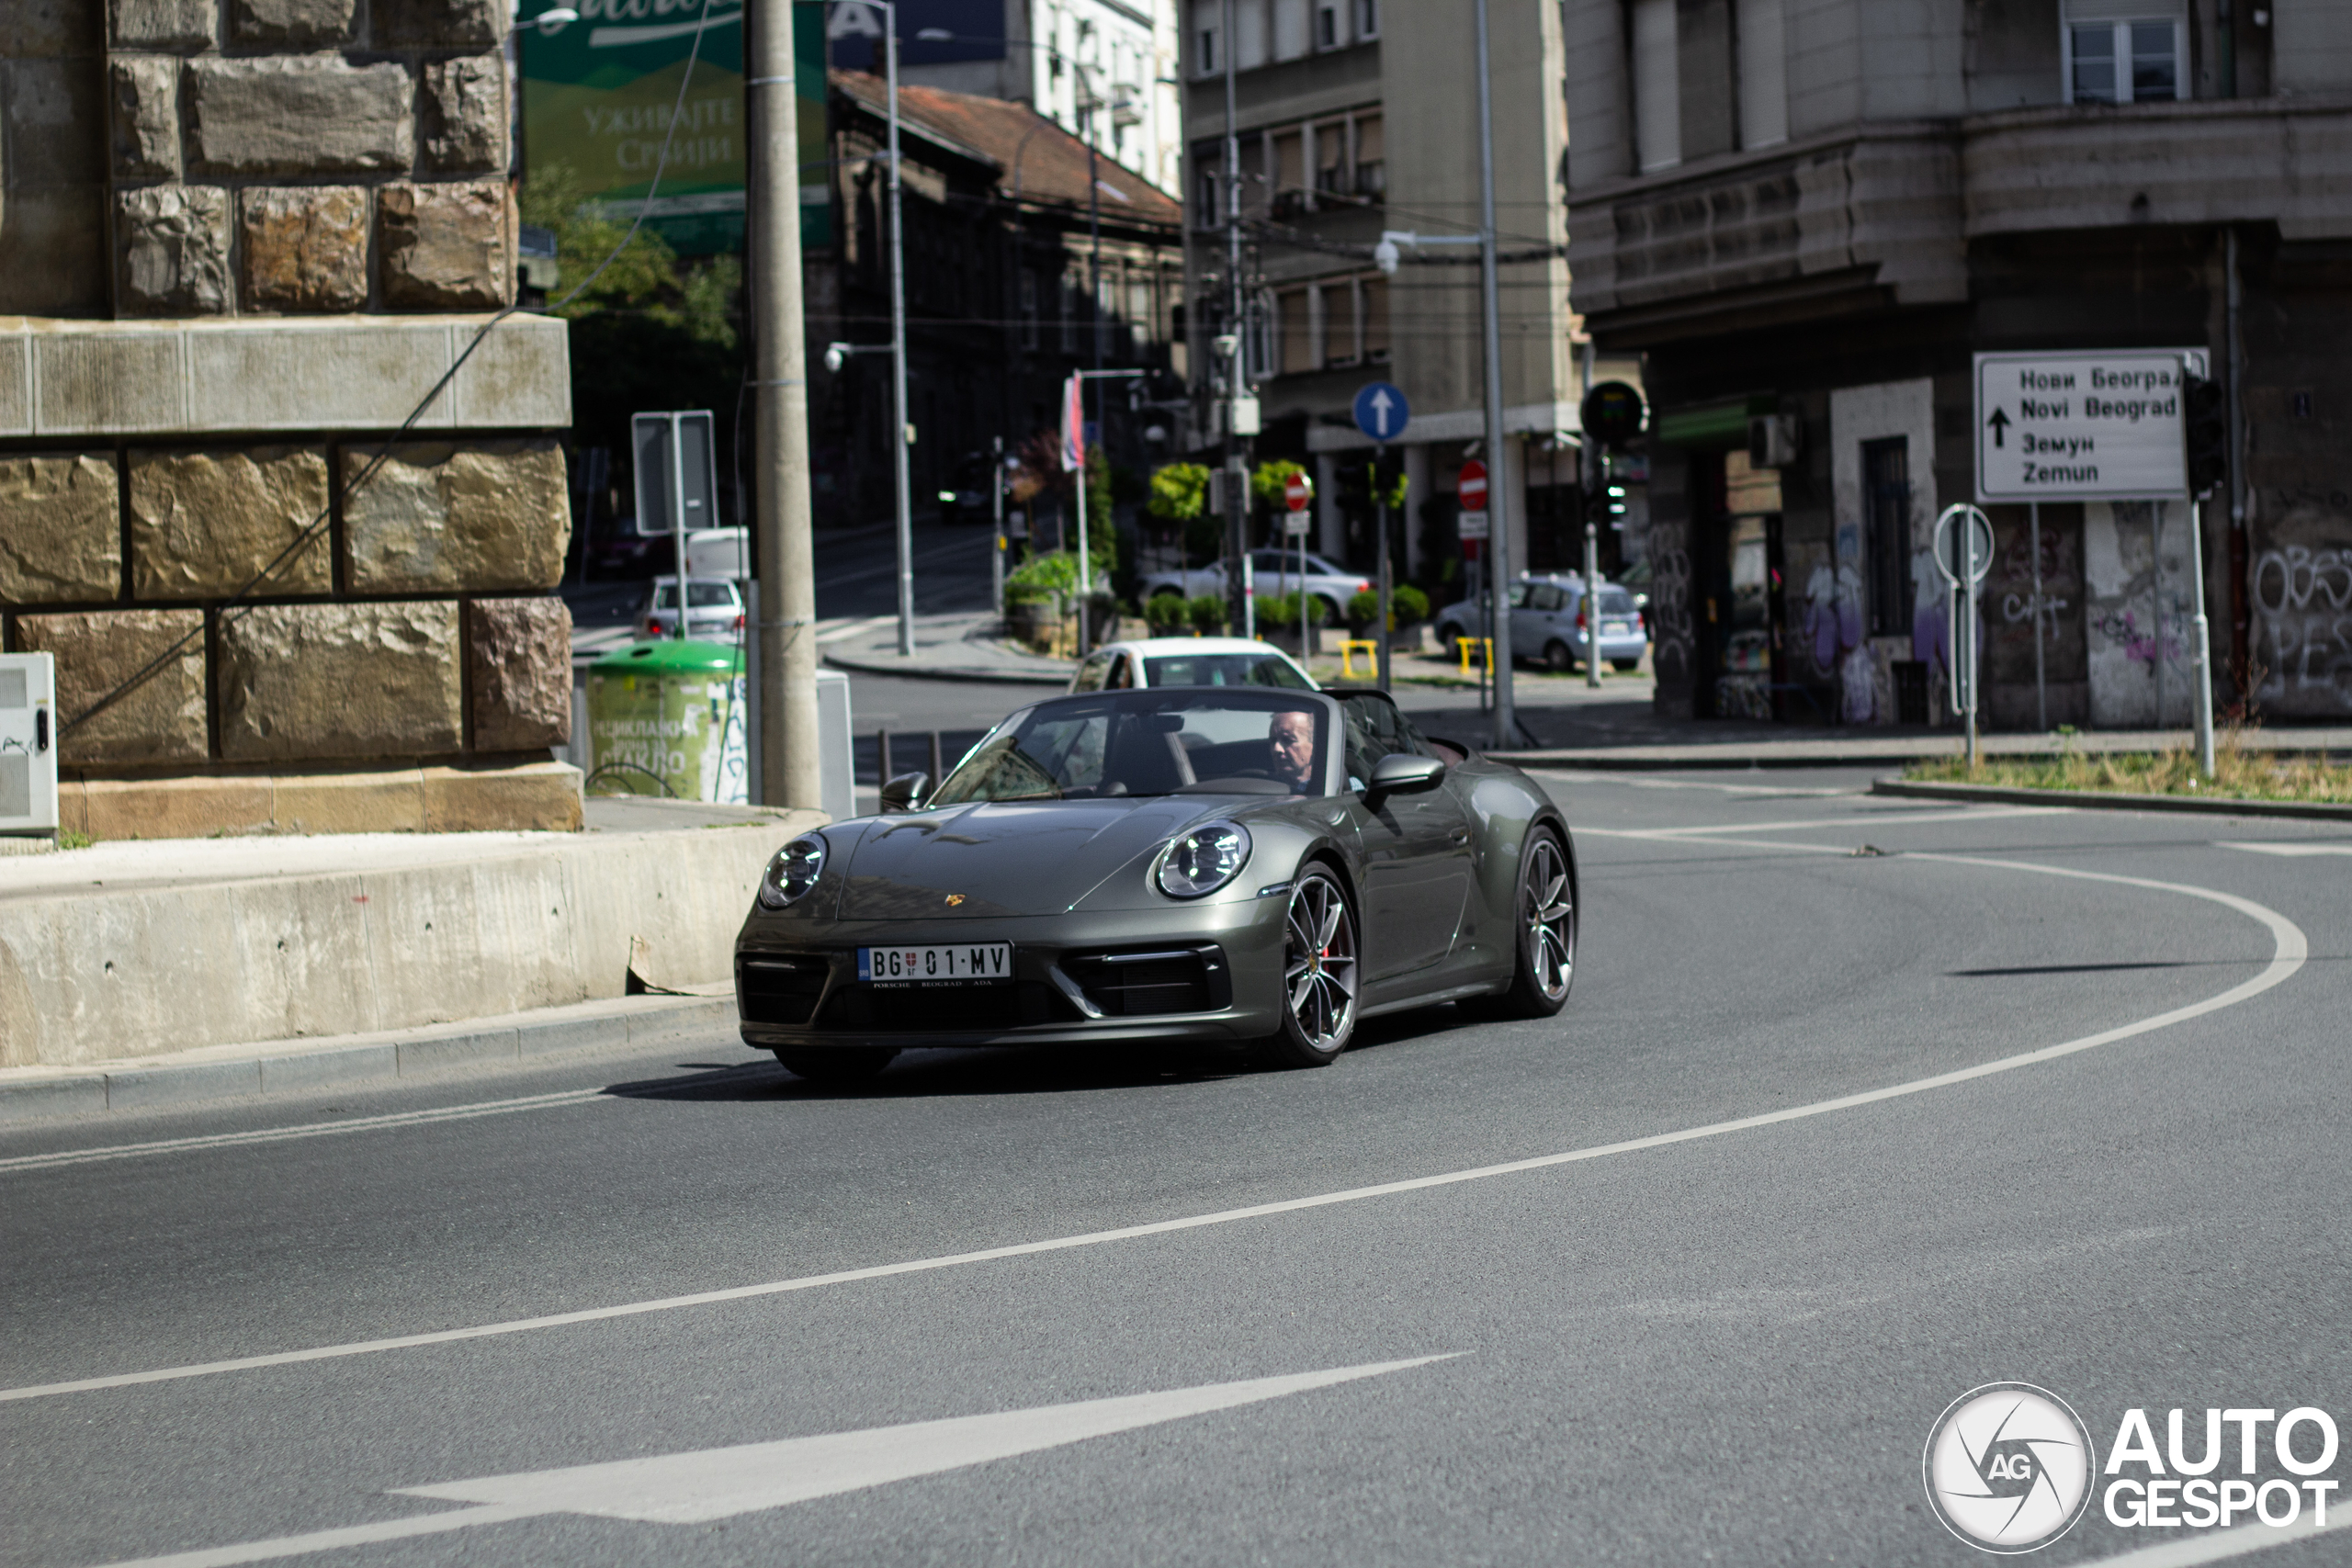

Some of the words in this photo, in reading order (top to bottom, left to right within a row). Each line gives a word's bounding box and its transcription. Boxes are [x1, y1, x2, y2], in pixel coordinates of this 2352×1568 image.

[2020, 369, 2075, 390] Нови
[2021, 398, 2069, 419] Novi
[2085, 395, 2177, 423] Beograd
[2022, 434, 2094, 458] Земун
[2023, 462, 2098, 483] Zemun
[859, 969, 869, 977] SRB
[874, 951, 900, 976] BG
